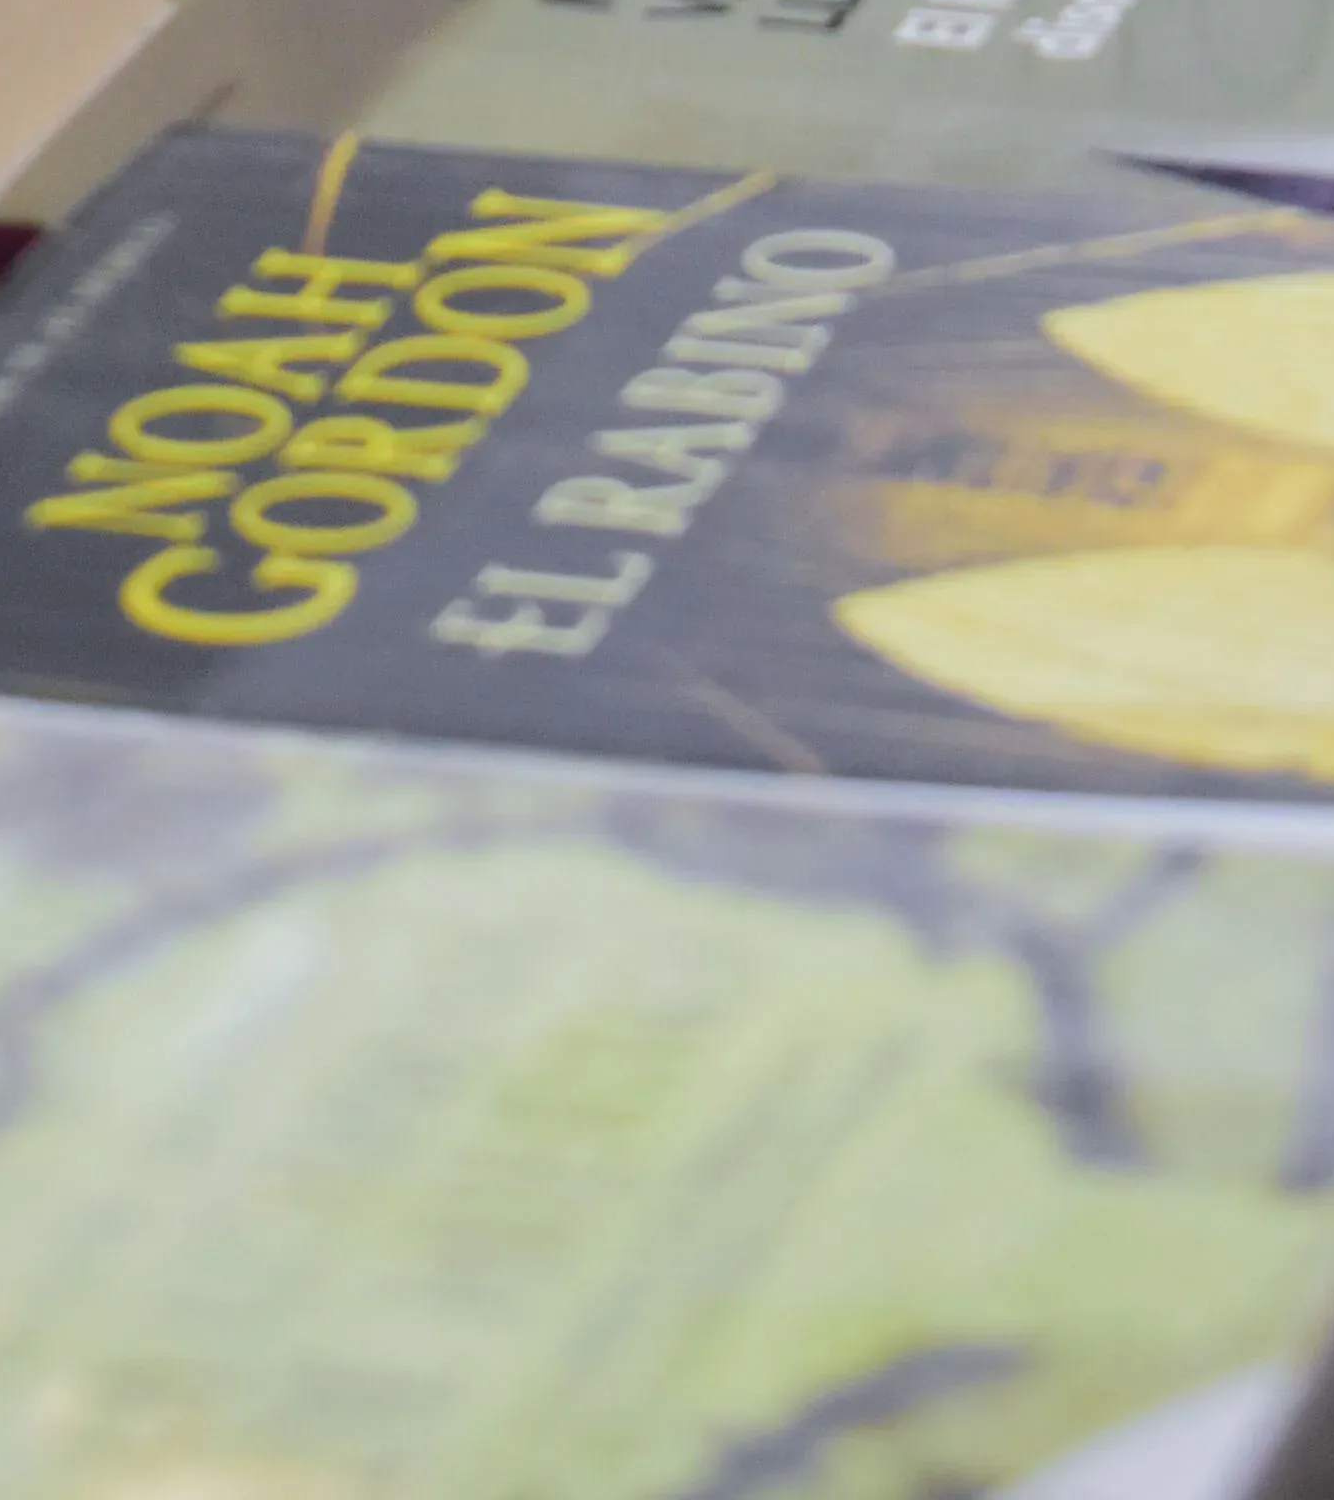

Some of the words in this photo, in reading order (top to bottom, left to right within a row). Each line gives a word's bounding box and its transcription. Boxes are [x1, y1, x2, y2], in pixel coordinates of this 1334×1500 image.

[27, 248, 425, 550] NOAH
[117, 190, 667, 655] GORDON
[533, 225, 903, 540] RABINO
[429, 490, 659, 663] EL
